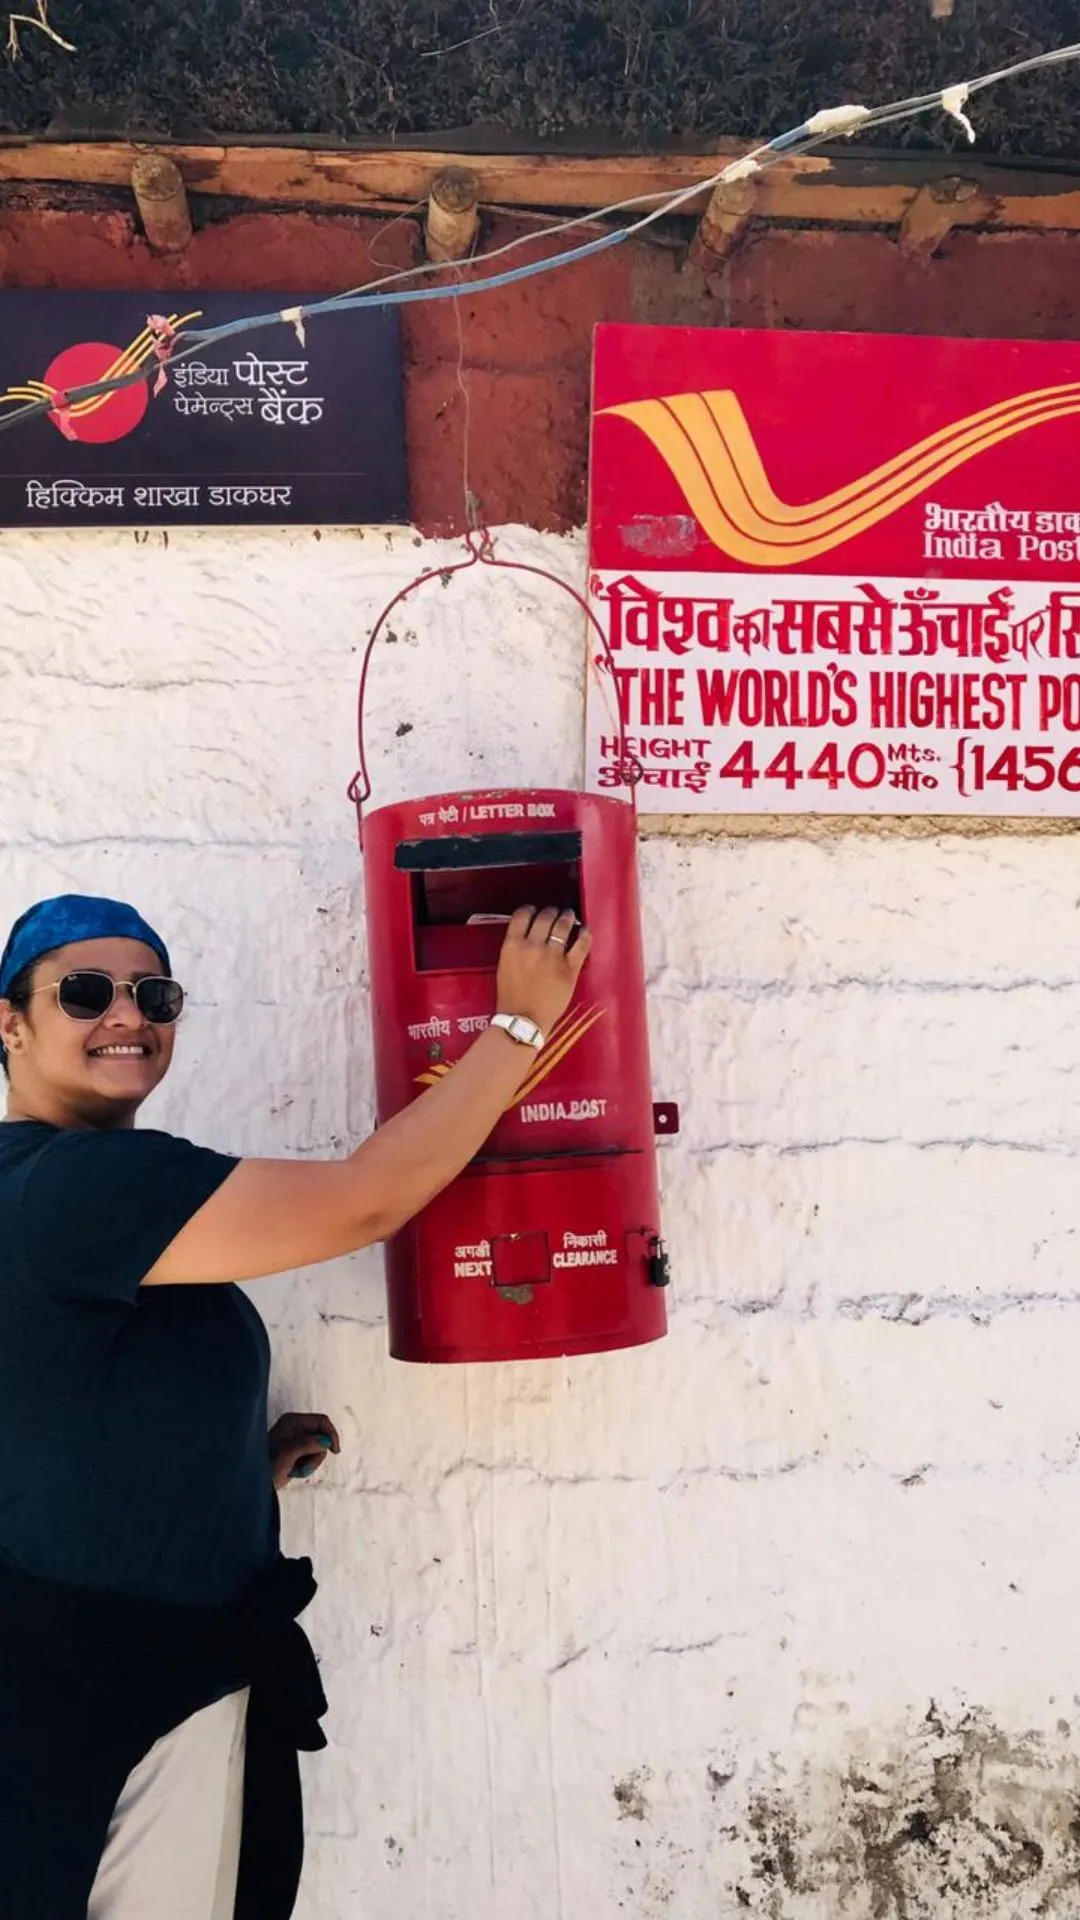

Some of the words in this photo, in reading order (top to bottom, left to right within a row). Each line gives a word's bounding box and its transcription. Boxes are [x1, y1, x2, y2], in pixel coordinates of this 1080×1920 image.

[172, 361, 230, 388] इंडिया
[232, 351, 309, 385] पोस्ट
[173, 391, 254, 421] पेमेन्ट्स
[257, 387, 325, 424] बैंक
[25, 479, 125, 509] हिक्किम
[133, 486, 200, 507] शाखा
[207, 486, 292, 507] डाकघर
[924, 501, 1033, 532] भारतीय
[922, 530, 1004, 560] India
[733, 608, 775, 656] का
[771, 583, 898, 655] सबसे
[1008, 605, 1052, 662] पर
[869, 670, 1028, 731] HIGHEST
[600, 735, 711, 759] HEIGHT
[719, 740, 886, 791] 4440
[887, 743, 942, 763] Mts.
[470, 804, 525, 820] LETTER
[527, 803, 556, 818] BOX
[407, 1015, 451, 1041] भारतीय
[520, 1101, 567, 1123] INDIA
[569, 1098, 607, 1121] POST
[563, 1229, 607, 1249] निकासी
[454, 1260, 493, 1278] NEXT
[552, 1249, 618, 1269] CLEARANCE
